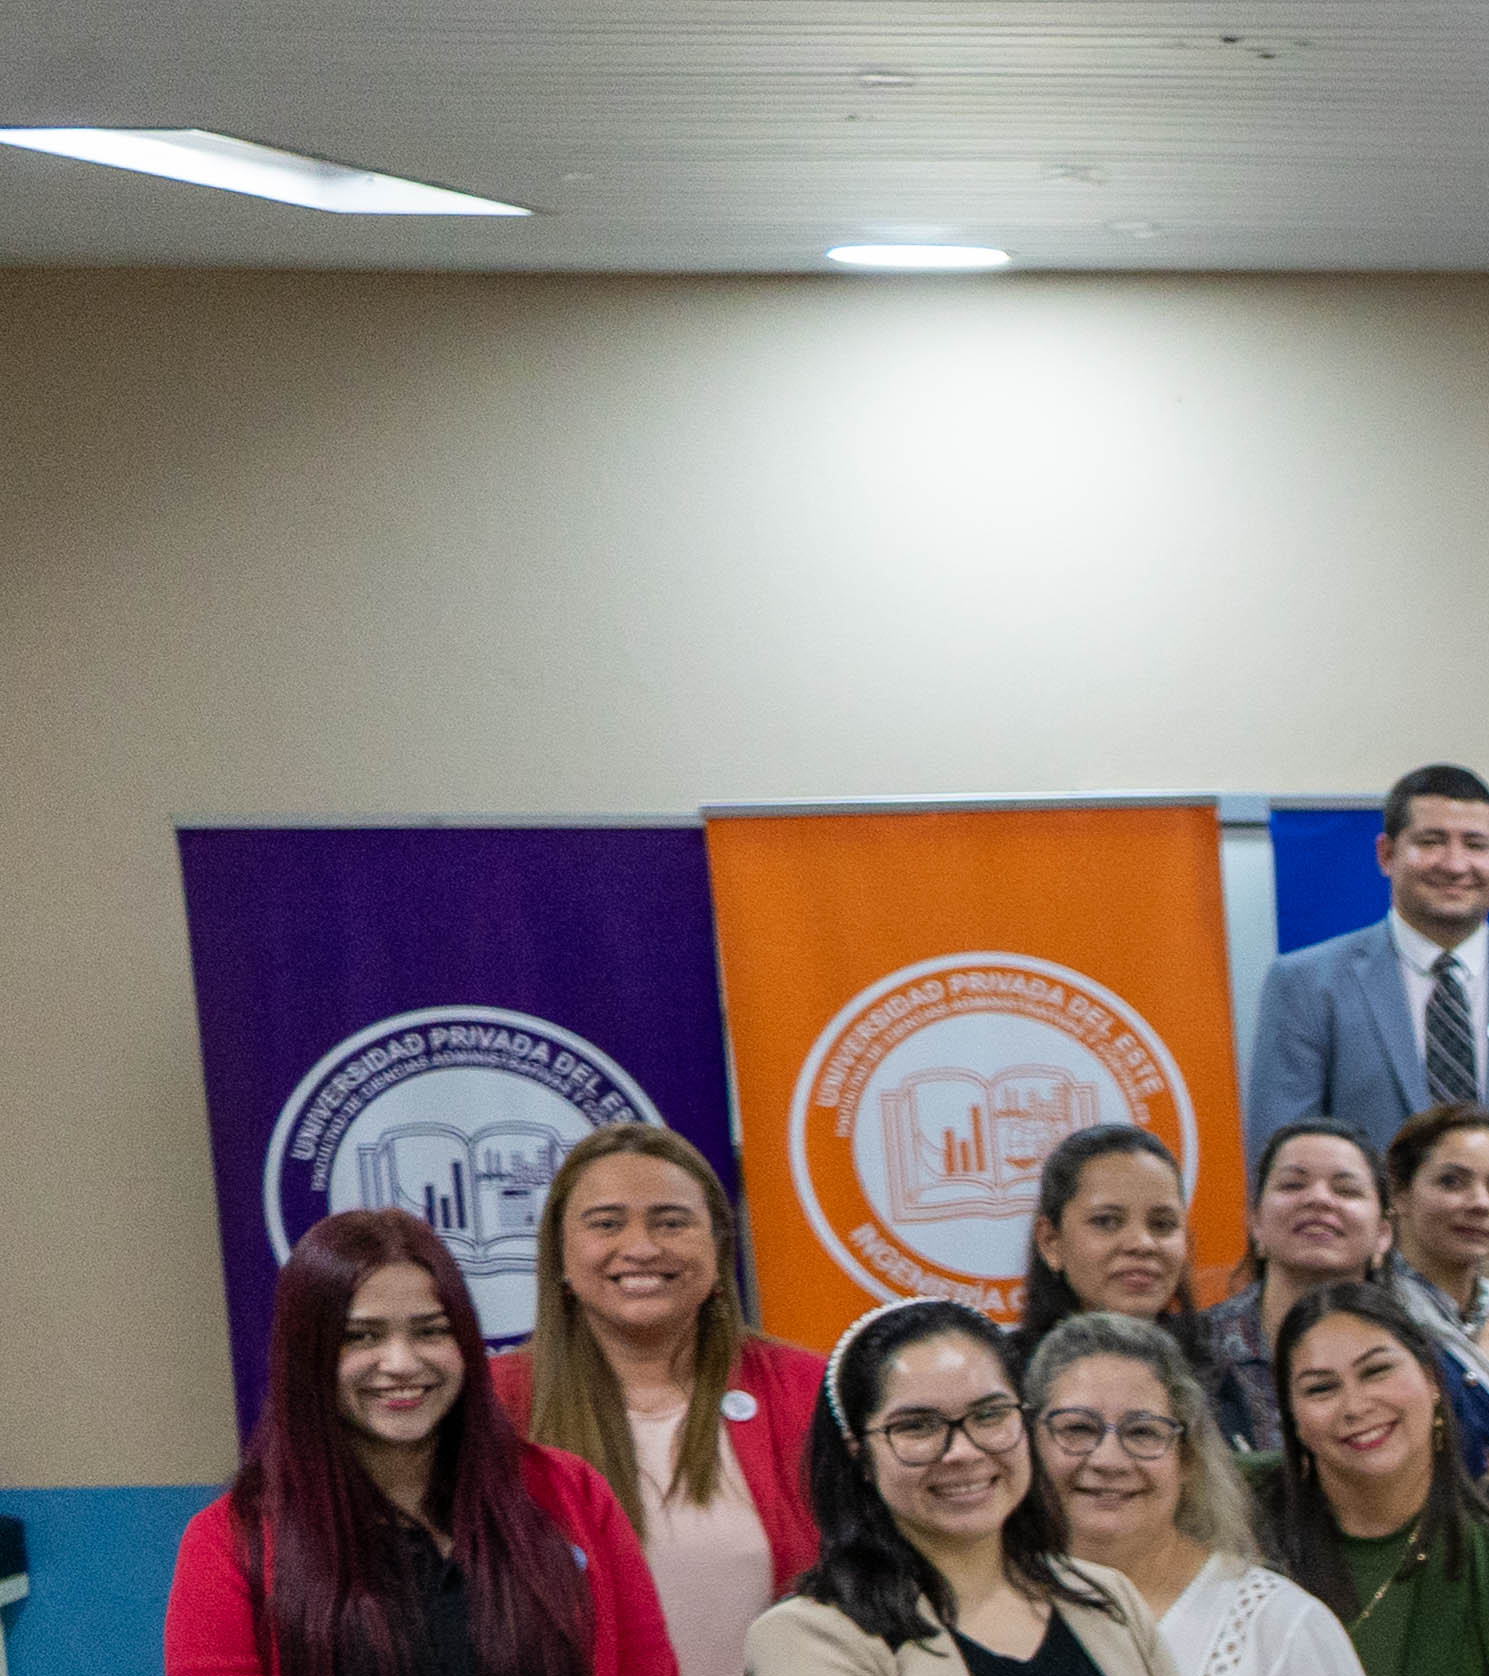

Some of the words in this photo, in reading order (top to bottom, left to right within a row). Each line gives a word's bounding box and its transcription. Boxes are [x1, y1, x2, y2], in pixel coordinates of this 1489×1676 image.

[289, 1032, 426, 1161] UNIVERSIDAD
[428, 1025, 550, 1064] PRIVADA
[553, 1051, 602, 1099] DEL
[815, 979, 945, 1108] UNIVERSIDAD
[946, 971, 1064, 1007] PRIVADA
[1068, 994, 1115, 1042] DEL
[1113, 1033, 1165, 1094] ESTE
